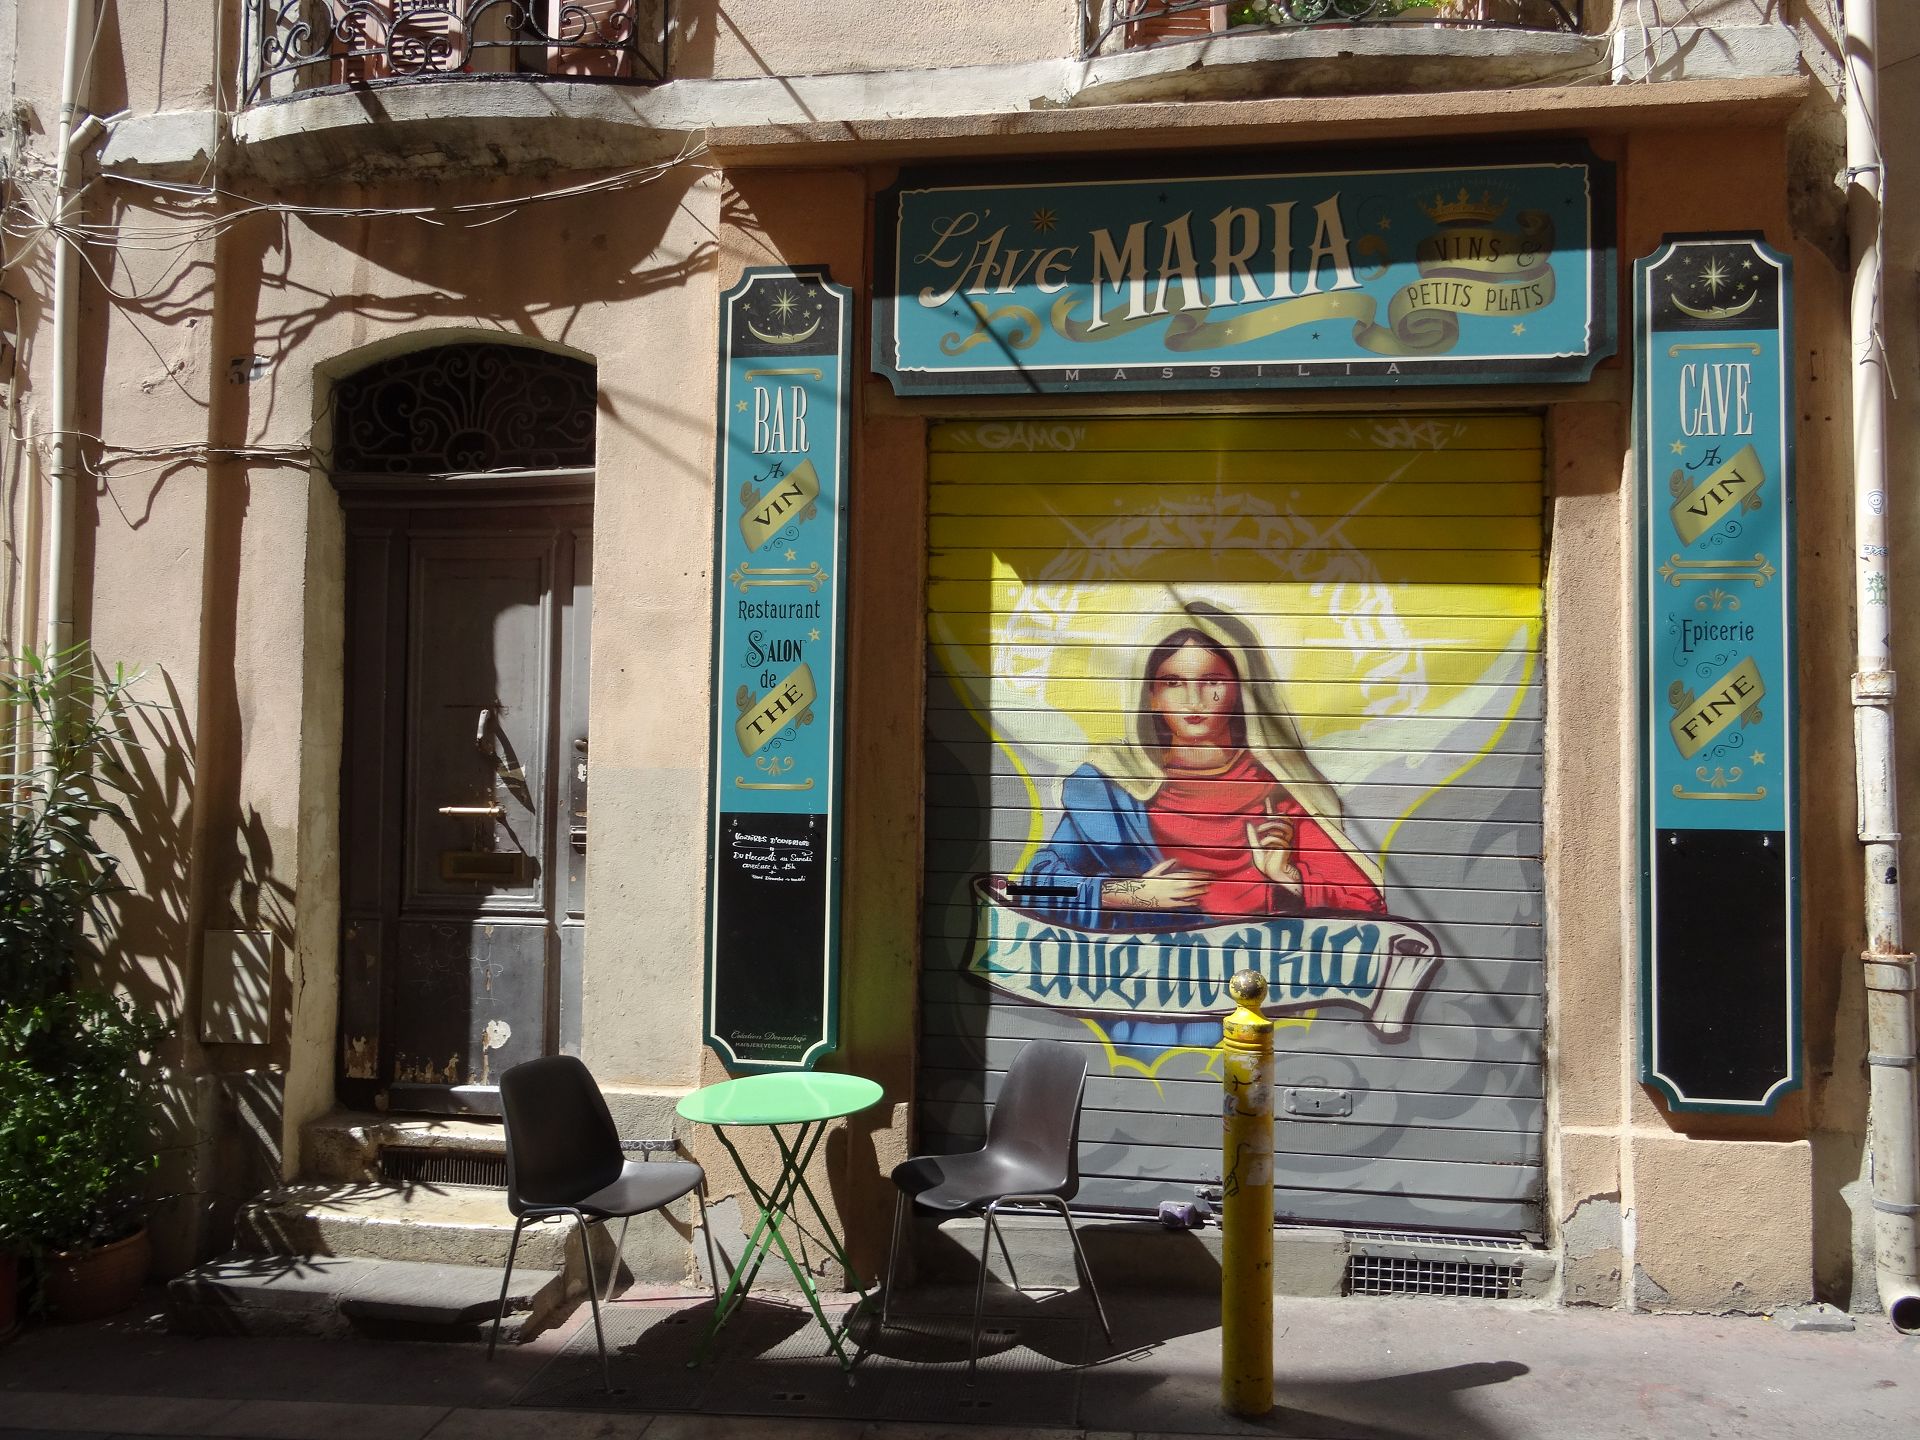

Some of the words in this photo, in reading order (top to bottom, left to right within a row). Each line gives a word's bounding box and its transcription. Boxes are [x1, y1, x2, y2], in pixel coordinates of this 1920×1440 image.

[1086, 191, 1364, 333] MARIA
[1433, 236, 1502, 263] VINS
[1516, 240, 1543, 268] &
[1406, 281, 1474, 310] PETITS
[1484, 282, 1545, 312] PLATS
[1064, 361, 1401, 382] MASSILIA
[1679, 362, 1753, 437] CAVE
[751, 385, 810, 454] BAR
[753, 459, 785, 483] A
[1685, 444, 1722, 471] A
[752, 482, 804, 527] VIN
[1686, 468, 1747, 517] VIN
[738, 599, 821, 622] Restaurant
[1681, 618, 1755, 653] Epicerie
[759, 669, 777, 689] de
[746, 683, 804, 736] THÉ
[1679, 674, 1756, 741] FINE
